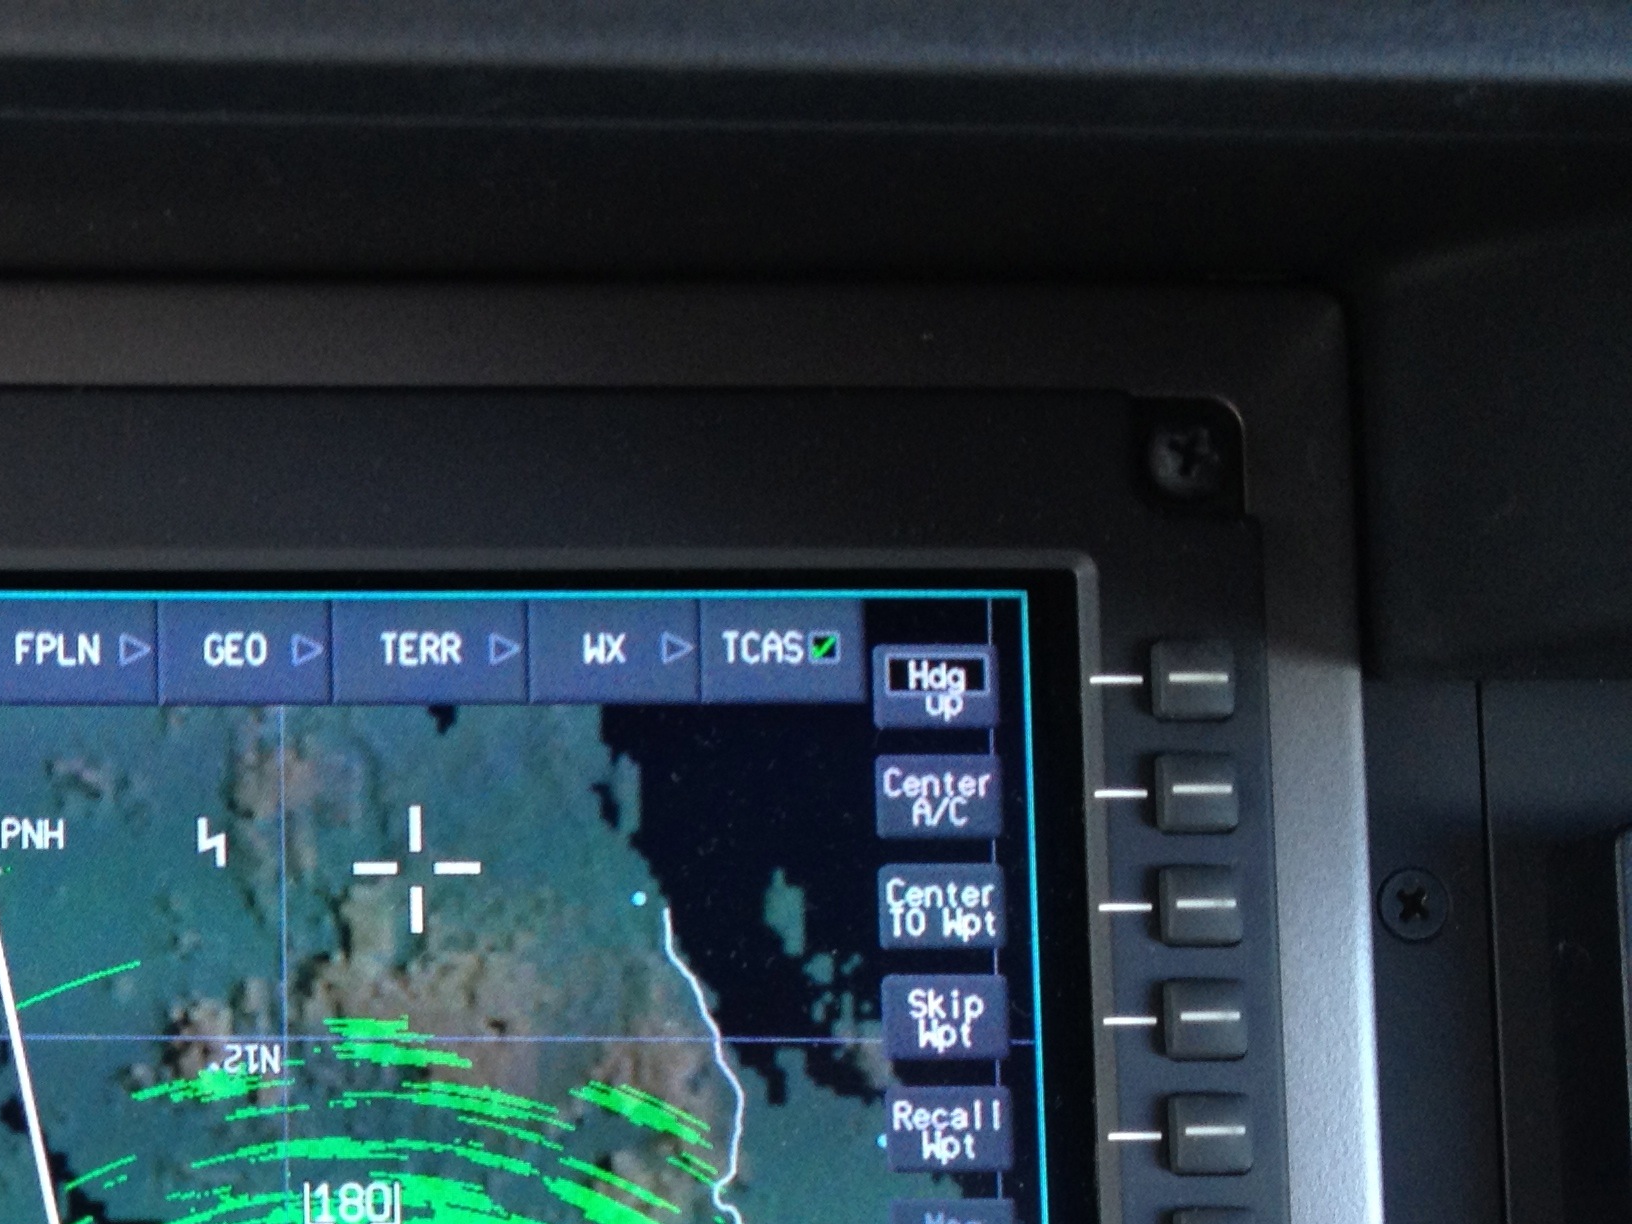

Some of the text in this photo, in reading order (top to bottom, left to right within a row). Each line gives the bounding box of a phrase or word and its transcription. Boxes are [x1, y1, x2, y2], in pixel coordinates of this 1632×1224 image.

[14, 632, 101, 666] FPLN
[204, 632, 267, 666] GEO
[381, 633, 462, 666] TERR
[583, 633, 627, 664] WX
[723, 631, 804, 664] TCAS
[908, 660, 966, 694] Hdg
[883, 768, 991, 798] Center
[912, 797, 968, 828] A/C
[1, 819, 64, 850] PNH
[886, 879, 994, 909] Center
[889, 908, 996, 941] TO Wpt
[908, 991, 984, 1023] Skip
[919, 1020, 972, 1053] Wpt
[893, 1101, 1001, 1130] Recall
[920, 1130, 975, 1162] Wpt
[313, 1181, 392, 1223] 180
